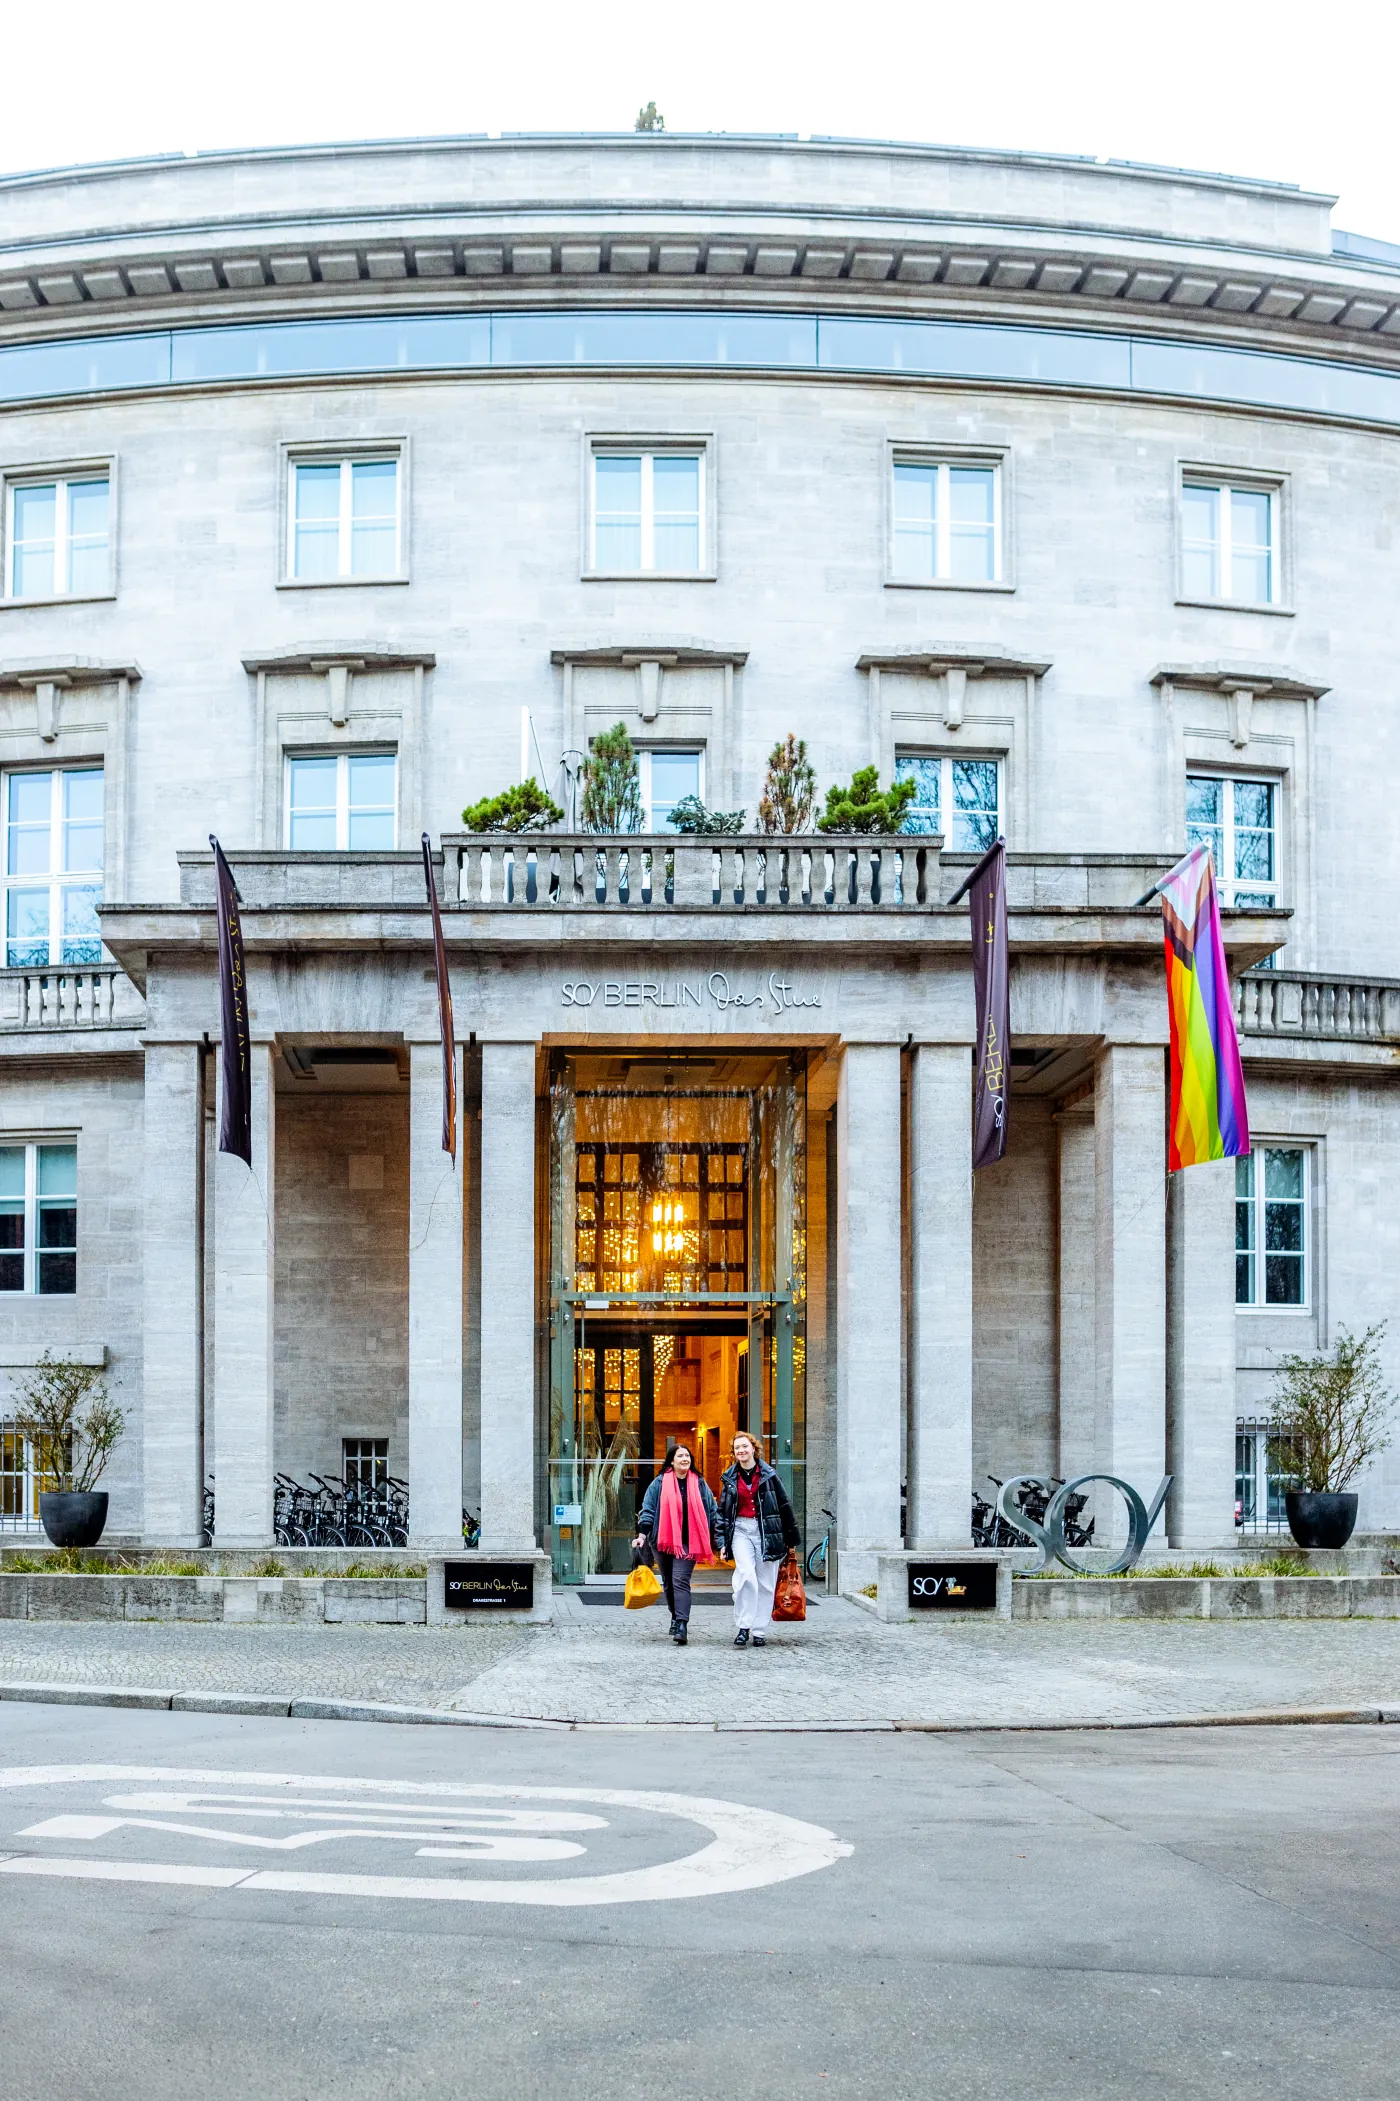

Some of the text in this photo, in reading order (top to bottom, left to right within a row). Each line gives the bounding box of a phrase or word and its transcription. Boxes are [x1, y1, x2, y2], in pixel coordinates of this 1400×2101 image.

[603, 982, 703, 1007] BERLIN
[707, 971, 764, 1011] Das
[768, 972, 823, 1015] Stue
[462, 1581, 492, 1590] BERLIN
[493, 1578, 511, 1591] Das
